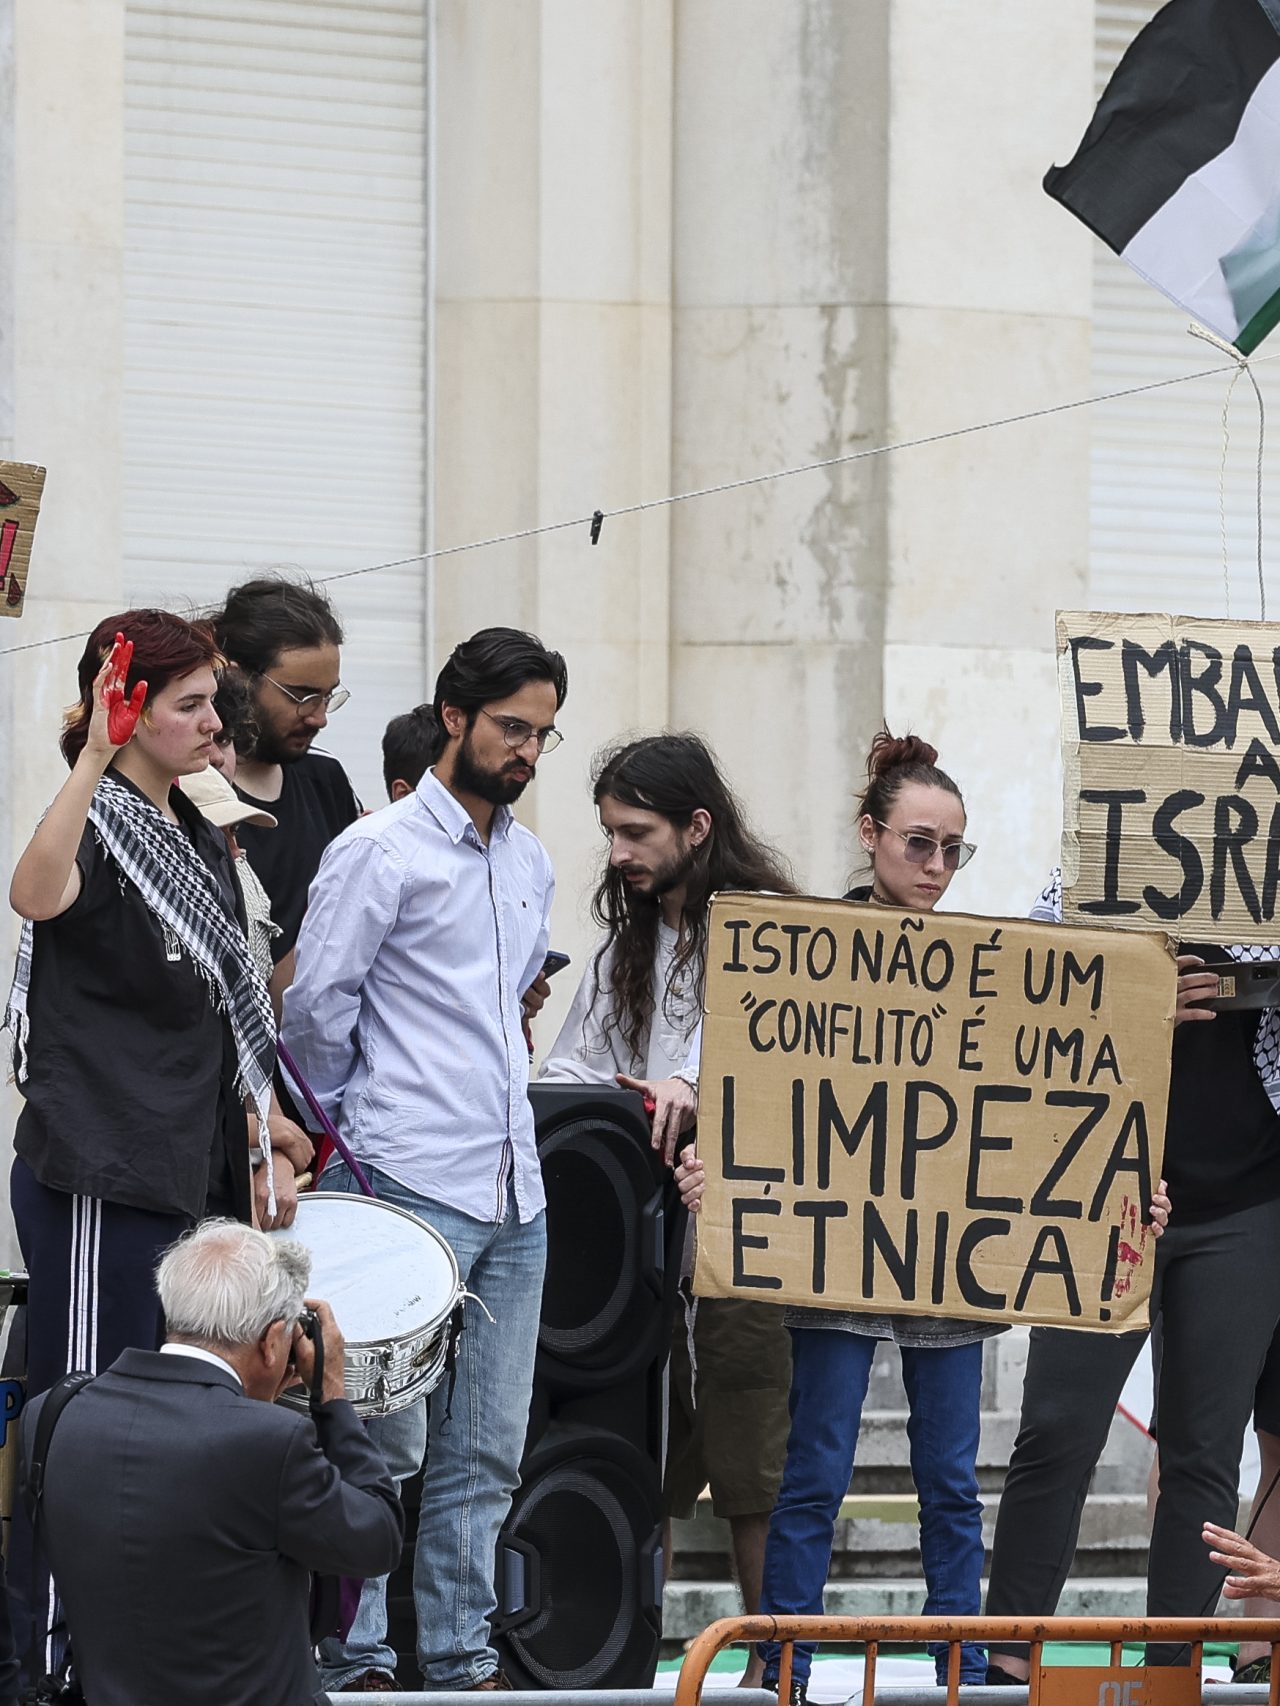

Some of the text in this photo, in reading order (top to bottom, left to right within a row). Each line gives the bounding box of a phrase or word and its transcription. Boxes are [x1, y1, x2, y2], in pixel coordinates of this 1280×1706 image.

[722, 918, 1104, 1011] ISTO NÃO É UM
[958, 1004, 985, 1072] É
[1015, 1024, 1123, 1086] UMA
[721, 1075, 1154, 1225] LIMPEZA
[731, 1182, 1121, 1322] ÉTNICA!
